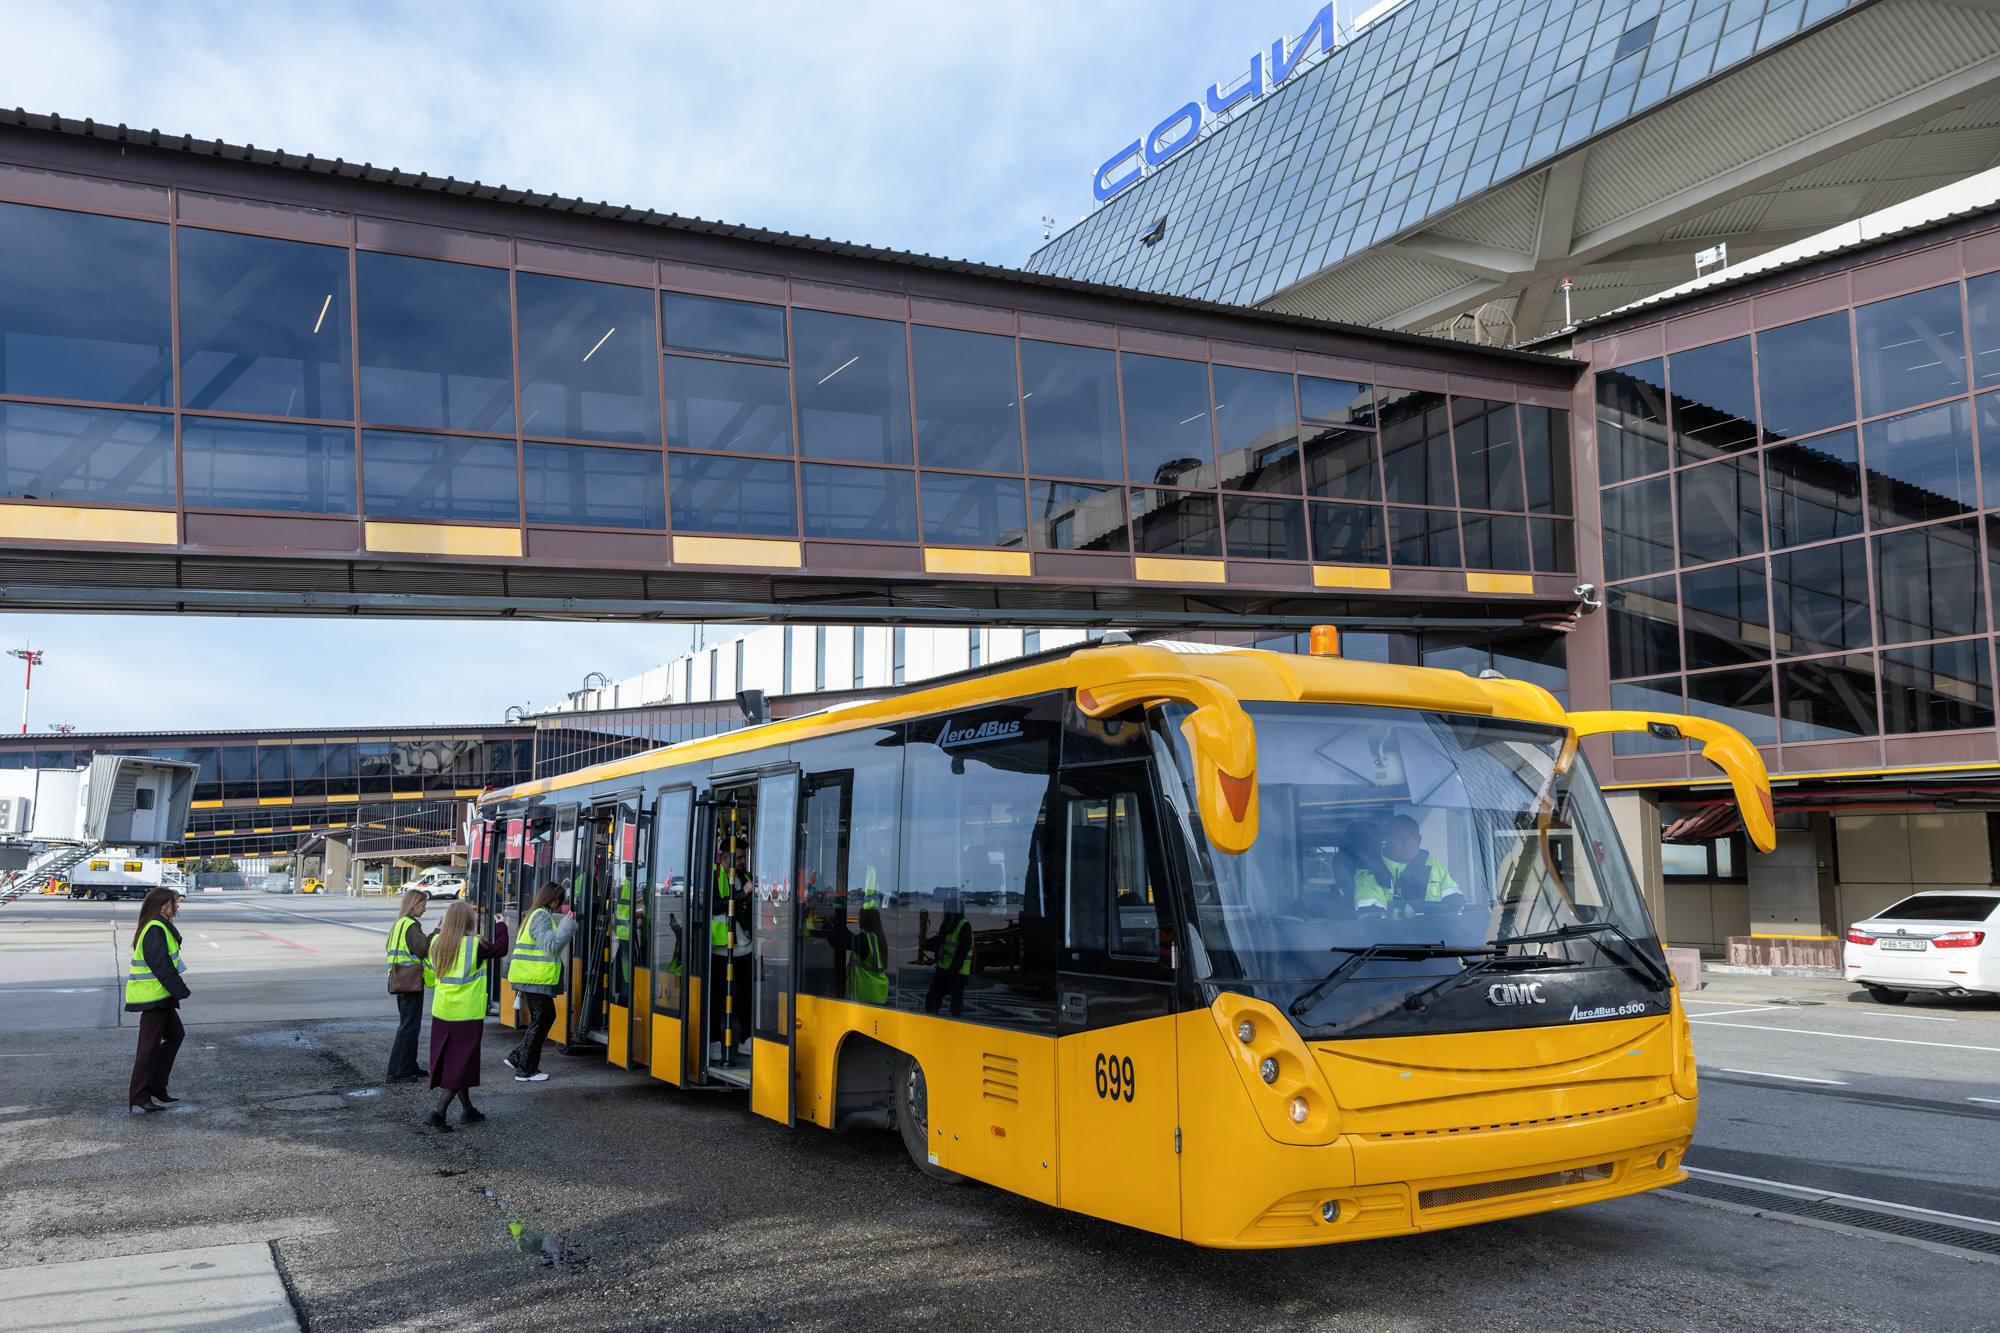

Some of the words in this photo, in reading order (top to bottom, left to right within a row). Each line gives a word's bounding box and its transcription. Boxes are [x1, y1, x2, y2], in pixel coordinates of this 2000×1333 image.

[1093, 0, 1337, 202] СОЧИ
[934, 719, 1024, 748] AeroABus
[1487, 982, 1546, 1006] CIMC
[1569, 1006, 1618, 1021] AeroABus
[1619, 1003, 1645, 1015] 6300
[1095, 1053, 1135, 1103] 699
